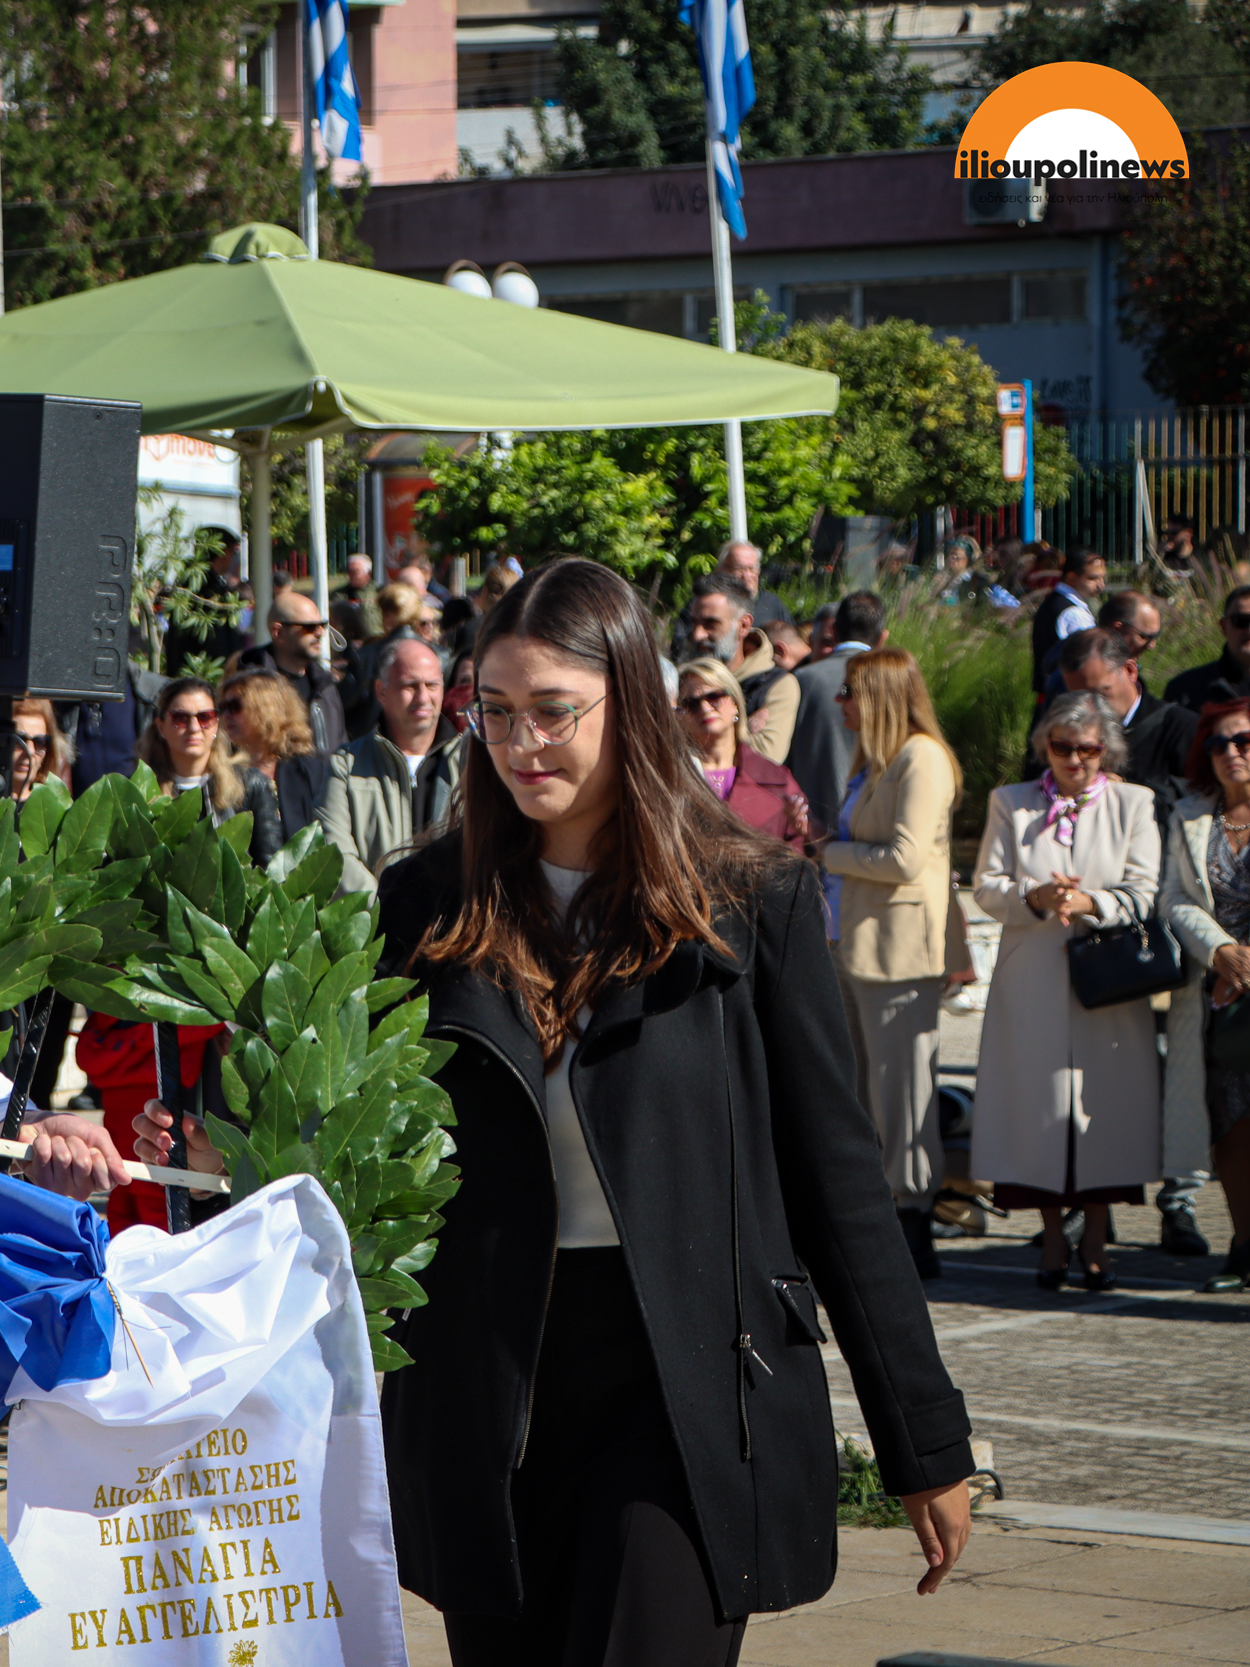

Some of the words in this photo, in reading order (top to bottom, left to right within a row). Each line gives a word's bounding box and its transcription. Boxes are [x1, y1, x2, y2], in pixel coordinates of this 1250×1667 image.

[93, 1458, 298, 1509] ΑΠΟΚΑΤΑΣΤΑΣΗΣ
[98, 1508, 195, 1546] ΕΙΔΙΚΗΣ
[208, 1494, 301, 1532] ΑΓΩΓΗΣ
[119, 1536, 282, 1595] ΠΑΝΑΓΙΑ
[67, 1580, 345, 1651] ΕΥΑΓΓΕΛΙΣΤΡΙΑ
